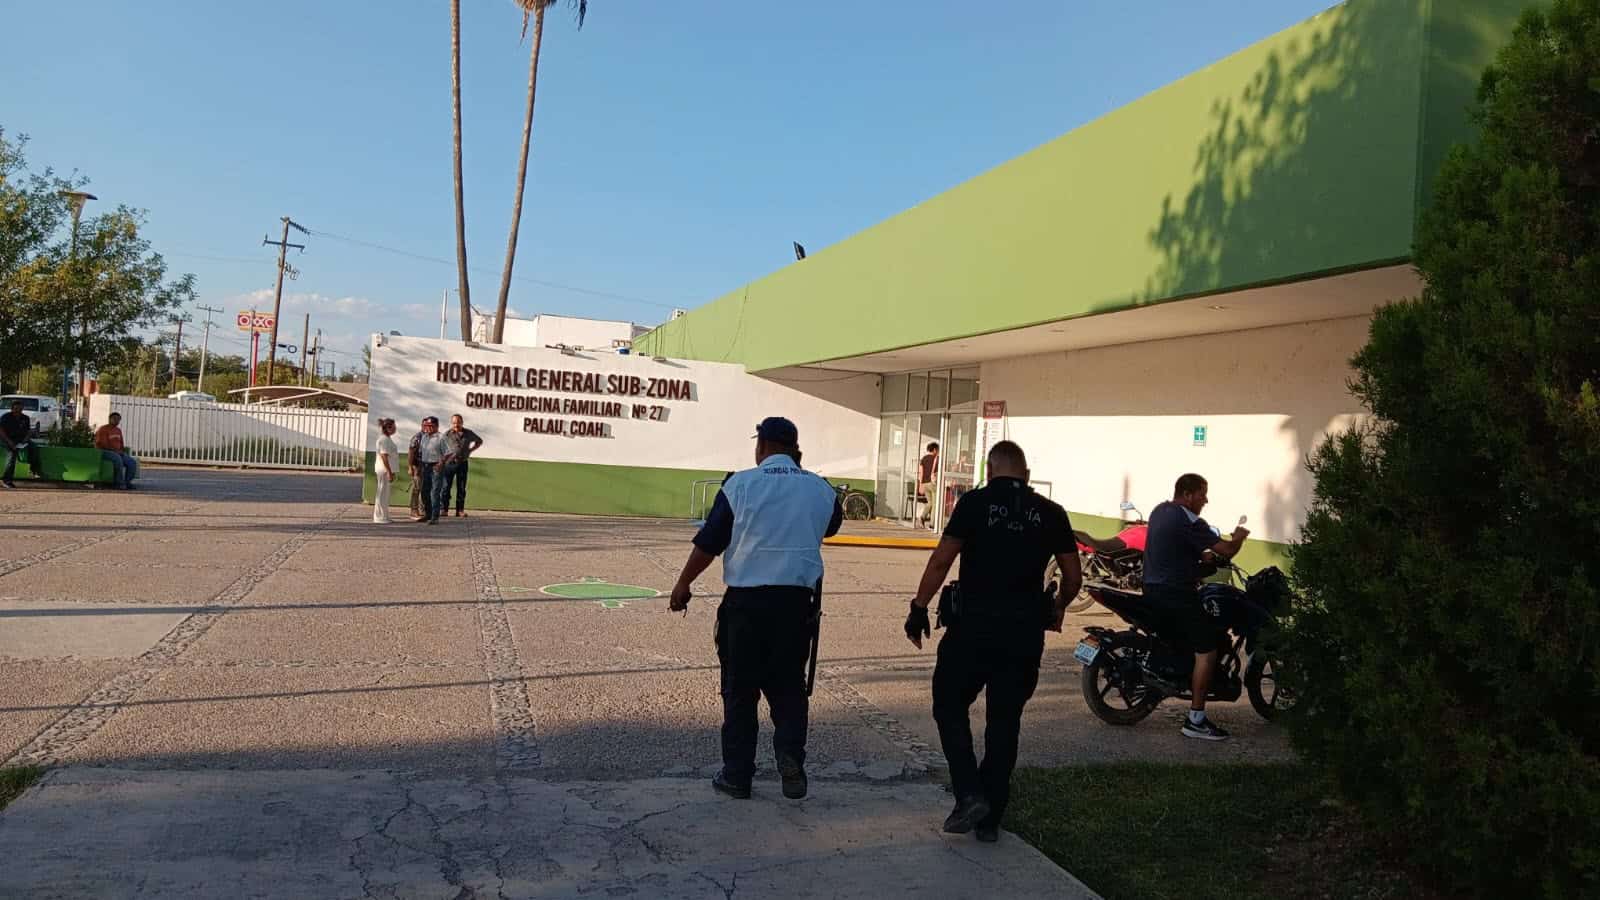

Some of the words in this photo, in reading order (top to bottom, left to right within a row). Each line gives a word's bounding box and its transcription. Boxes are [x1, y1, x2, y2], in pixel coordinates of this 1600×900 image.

[436, 361, 522, 388] HOSPITAL
[526, 368, 603, 394] GENERAL
[606, 374, 691, 400] SUB-ZONA
[466, 391, 493, 409] CON
[496, 394, 560, 414] MEDICINA
[563, 398, 621, 417] FAMILIAR
[649, 405, 664, 421] 27
[523, 417, 567, 438] PALAU,
[570, 420, 608, 438] COAH.
